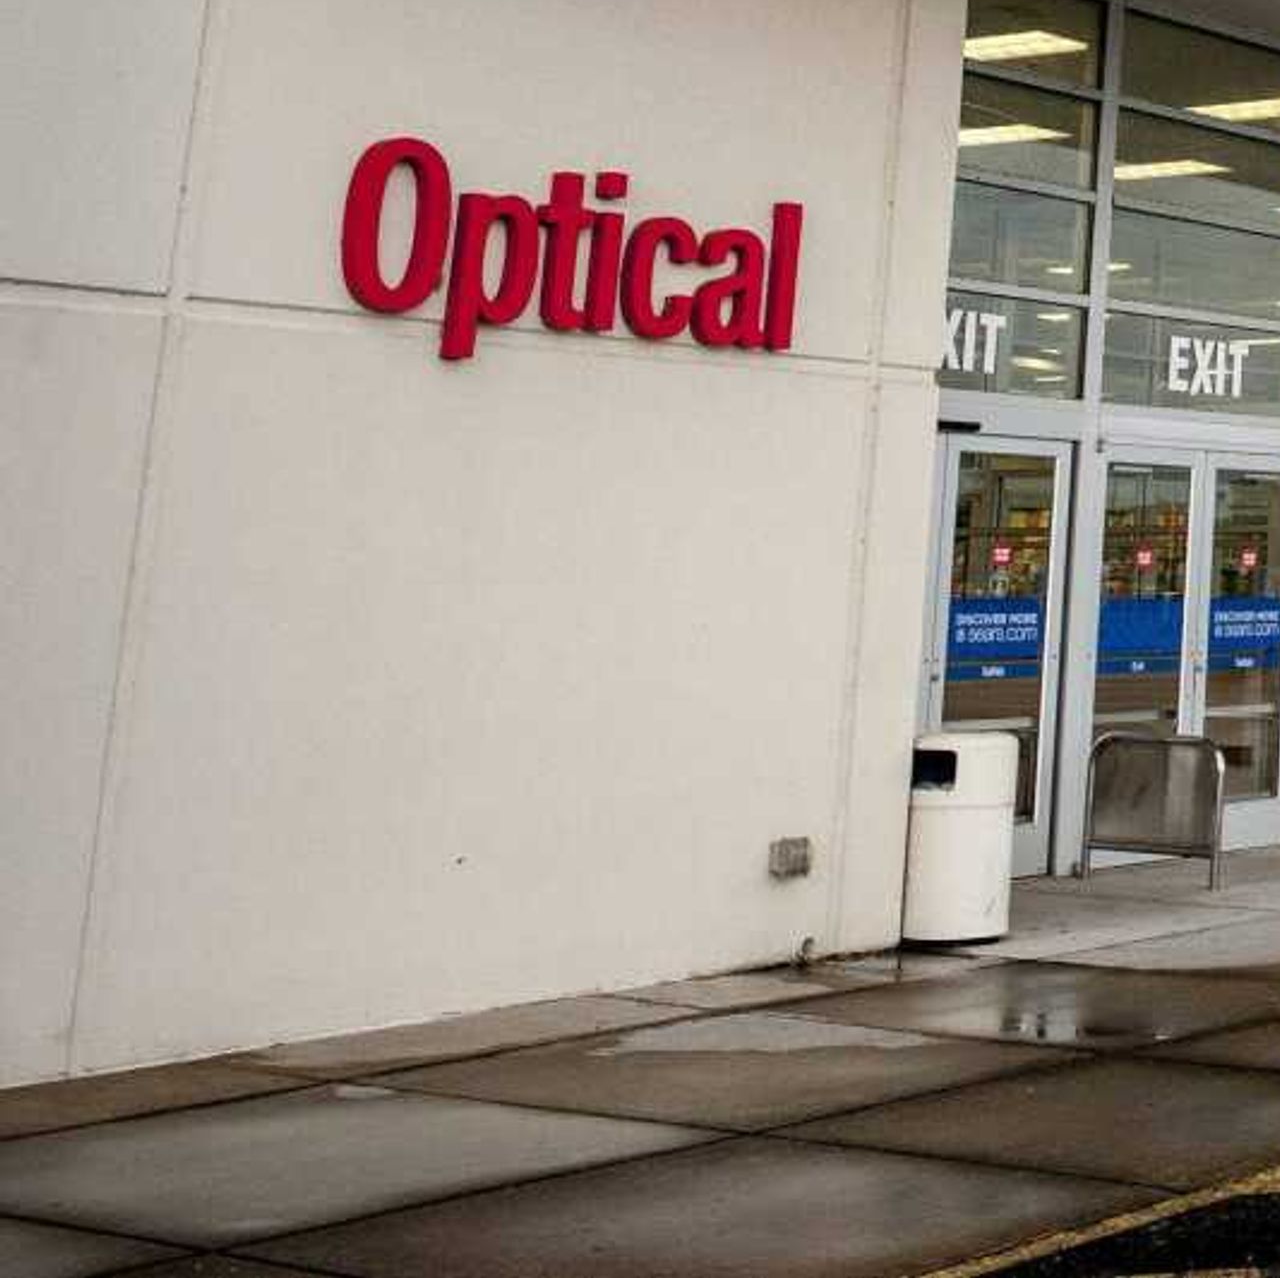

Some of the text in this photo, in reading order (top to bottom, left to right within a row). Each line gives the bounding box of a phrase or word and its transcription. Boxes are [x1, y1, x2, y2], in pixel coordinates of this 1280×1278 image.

[341, 136, 803, 360] Optical
[942, 308, 1006, 374] XIT
[1168, 335, 1250, 398] EXIT
